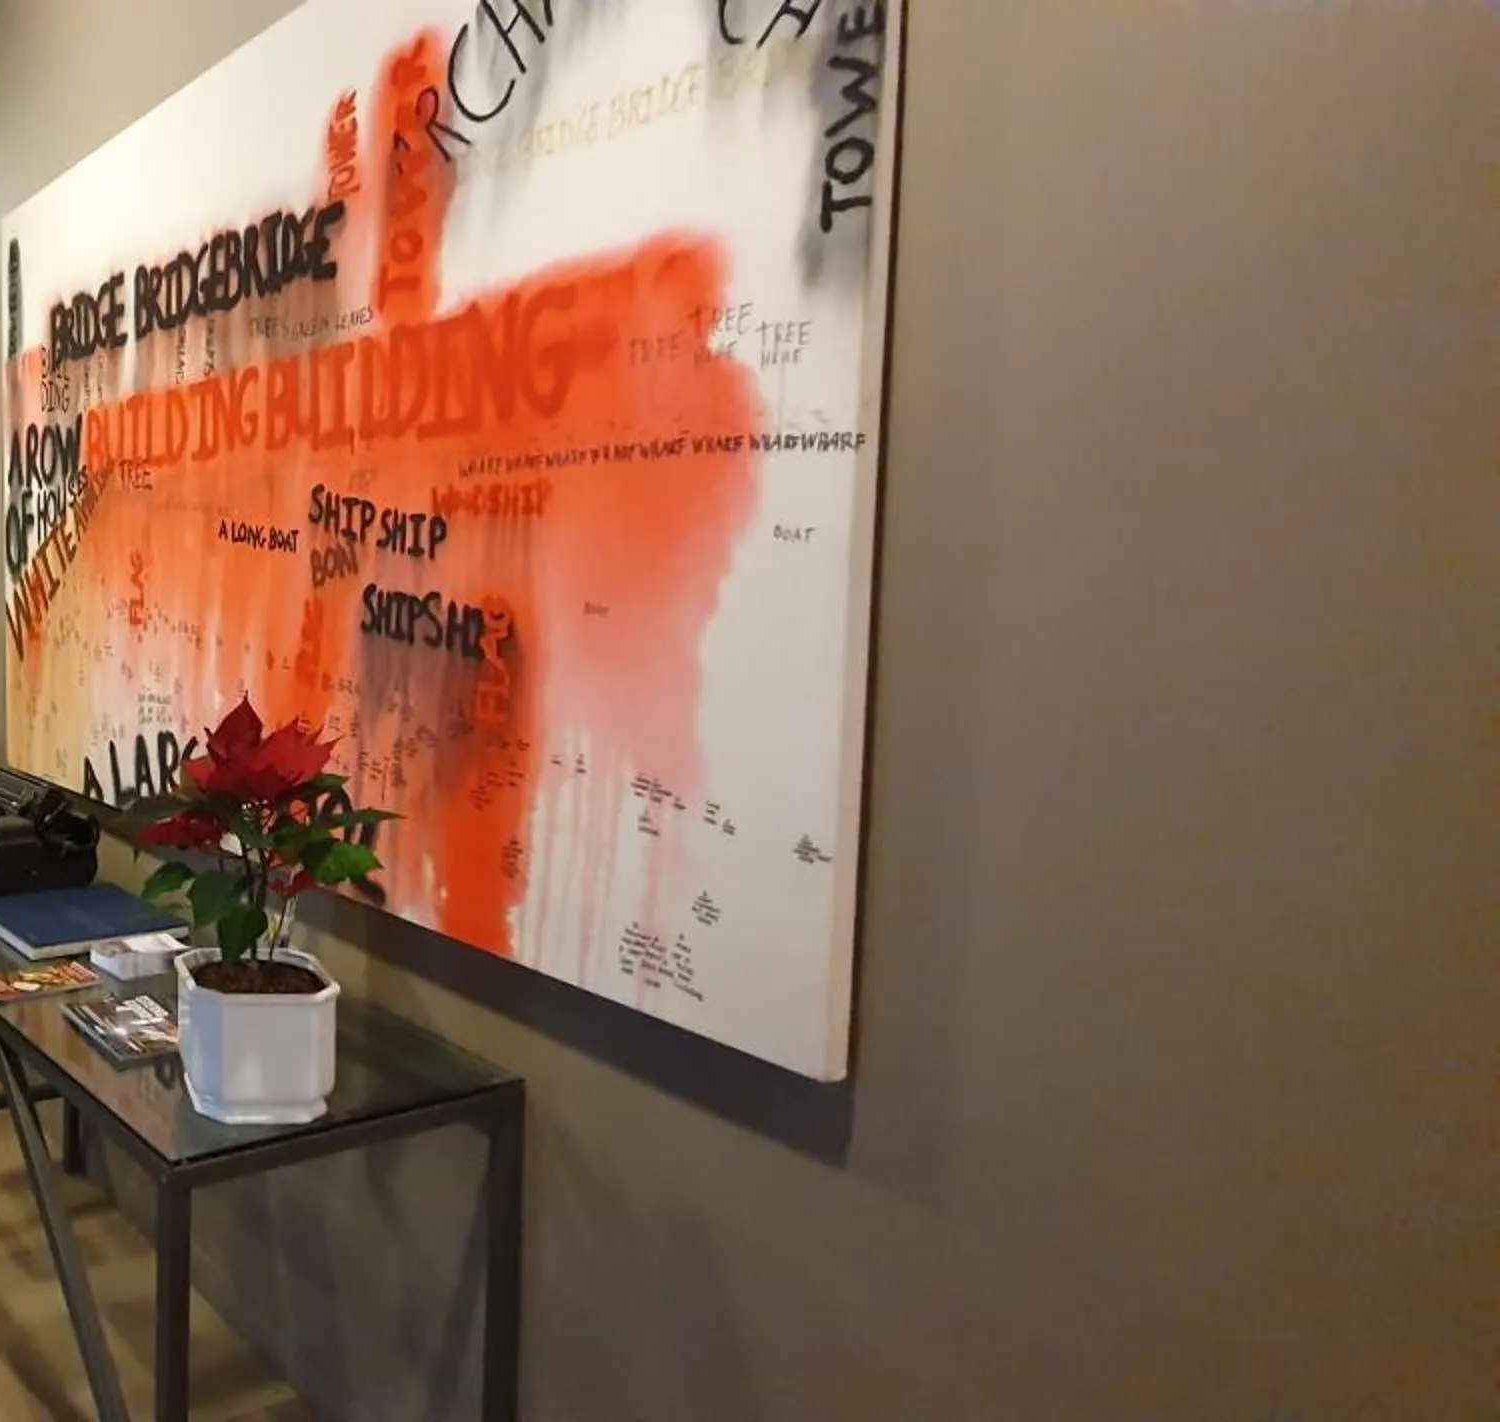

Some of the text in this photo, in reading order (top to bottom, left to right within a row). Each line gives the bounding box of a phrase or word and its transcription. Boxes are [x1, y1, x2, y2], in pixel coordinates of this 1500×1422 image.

[328, 90, 360, 201] TOWER
[51, 271, 129, 372] BRIDGE
[687, 302, 754, 338] TREE
[756, 320, 814, 351] TREE
[87, 365, 260, 474] BUILDING
[266, 283, 578, 452] BUILDING
[5, 488, 34, 584] OF
[218, 519, 299, 554] A LONG BOAT
[308, 484, 447, 560] SHIP SHIP
[772, 523, 819, 544] BOAT
